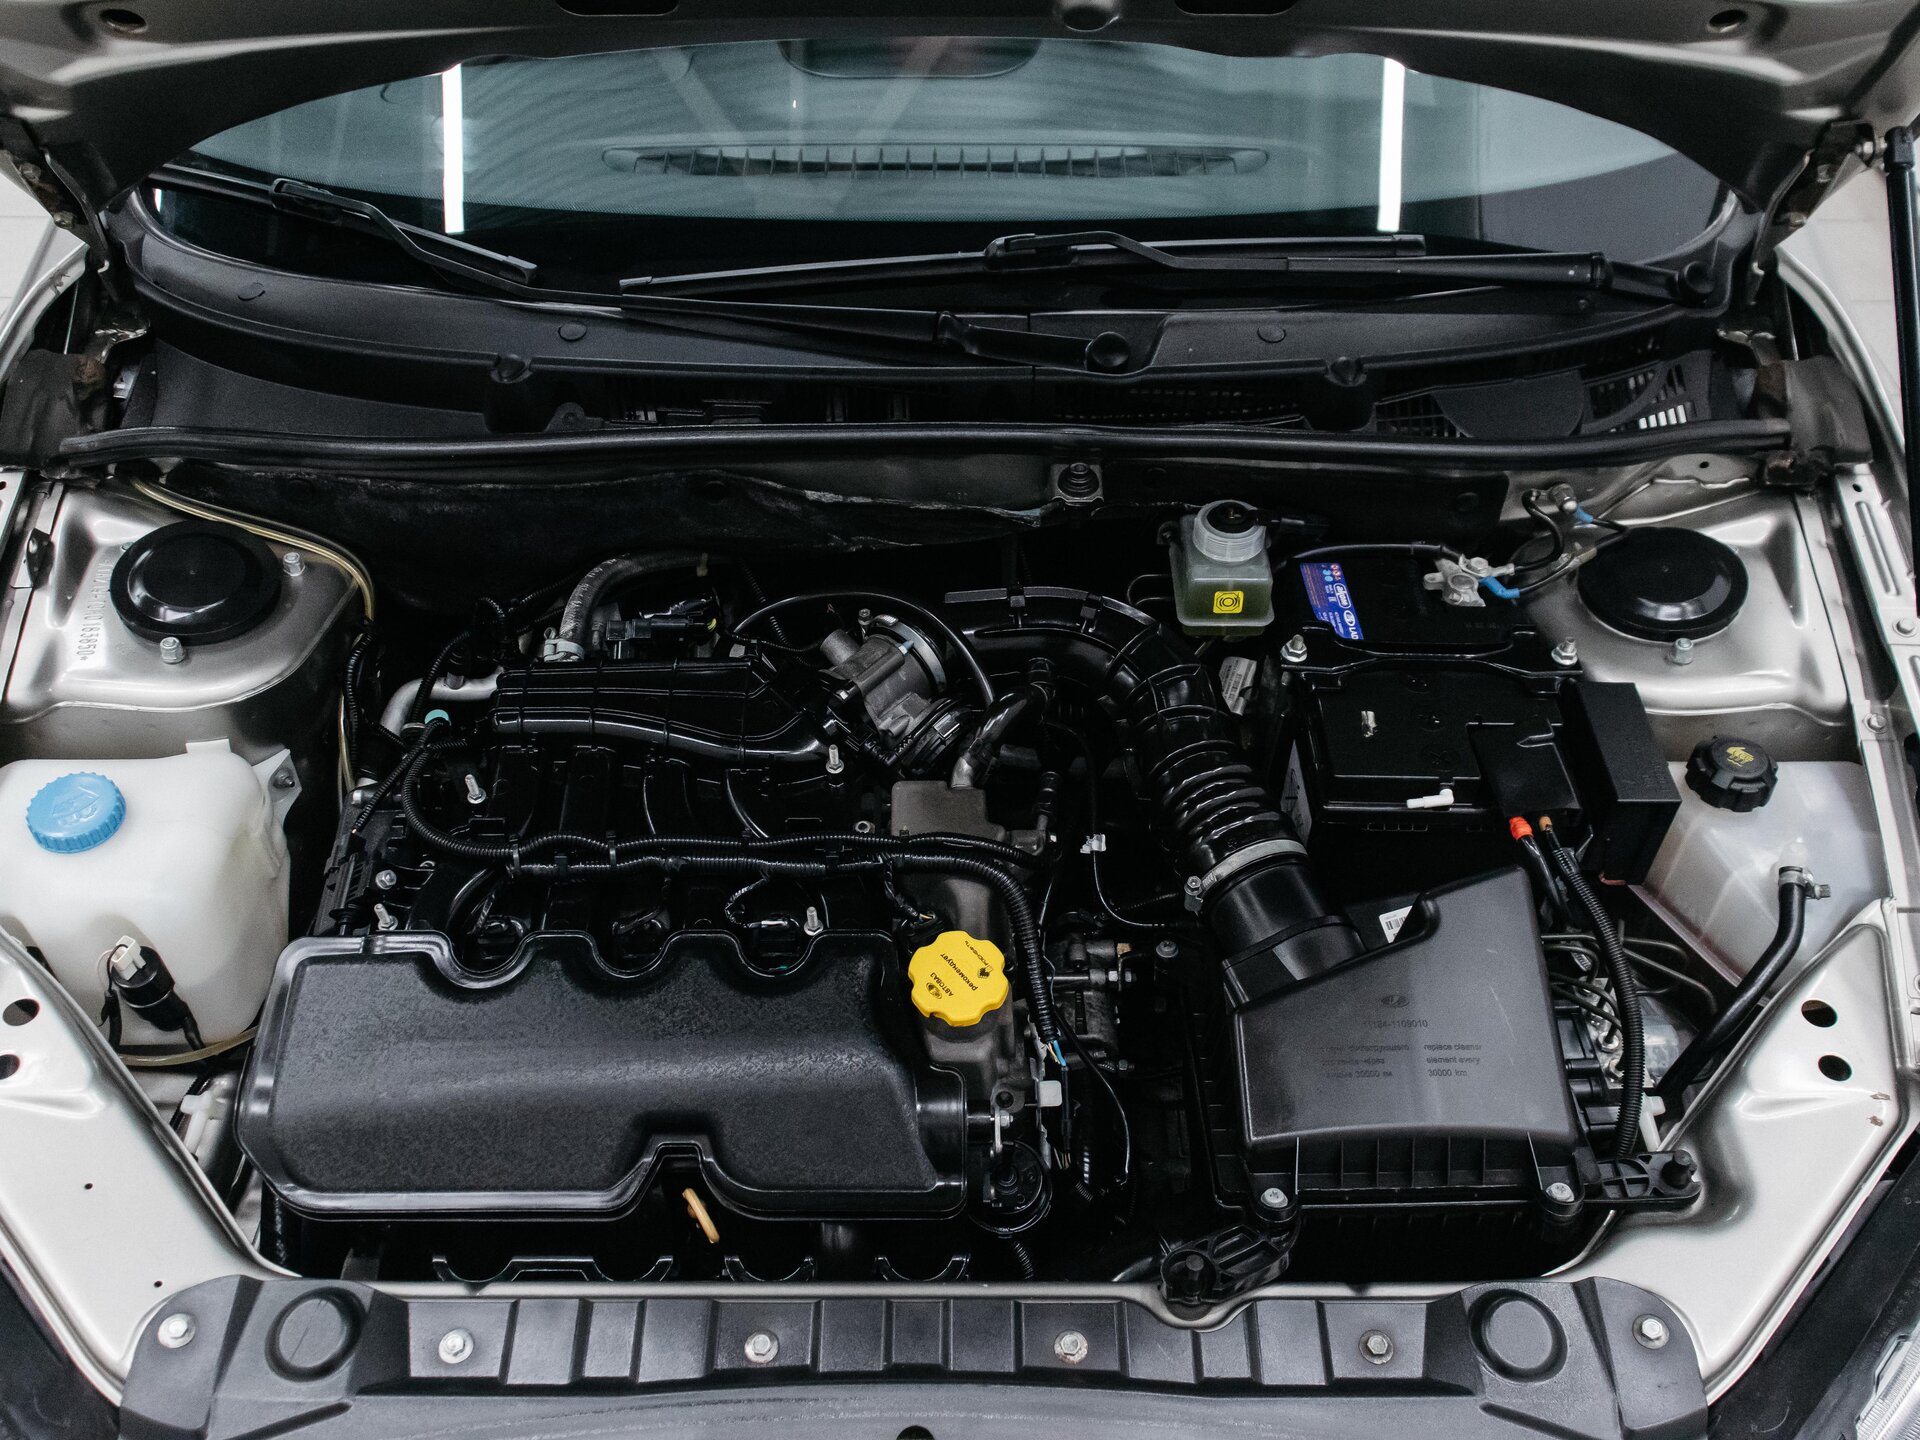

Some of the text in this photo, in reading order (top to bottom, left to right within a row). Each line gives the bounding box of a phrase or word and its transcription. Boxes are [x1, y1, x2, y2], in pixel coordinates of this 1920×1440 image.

[1349, 627, 1360, 640] LAD
[940, 952, 979, 991] рекомендует
[930, 972, 955, 997] АВТОВАЗ
[1427, 1068, 1468, 1077] 30000 km
